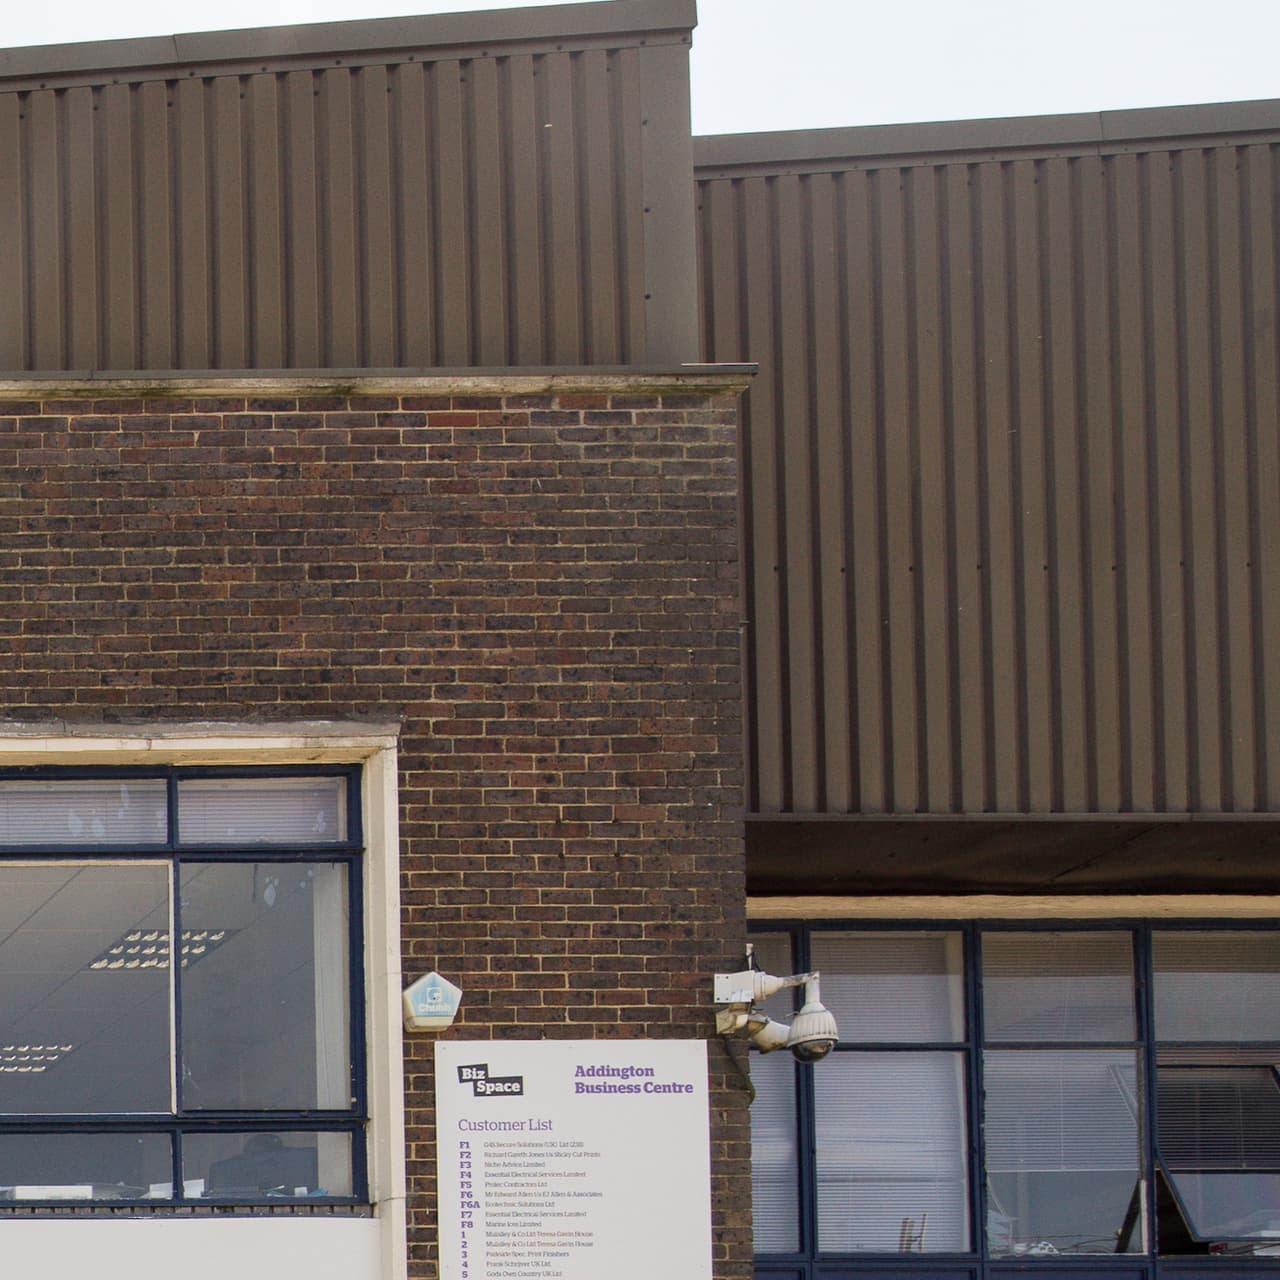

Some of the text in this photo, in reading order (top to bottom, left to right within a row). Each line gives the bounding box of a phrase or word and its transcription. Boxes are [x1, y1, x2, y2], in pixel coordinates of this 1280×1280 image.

[462, 1067, 486, 1080] Biz
[574, 1065, 654, 1081] Addington
[476, 1080, 521, 1095] Space
[574, 1082, 694, 1094] Business Centre
[458, 1118, 552, 1131] Customer List
